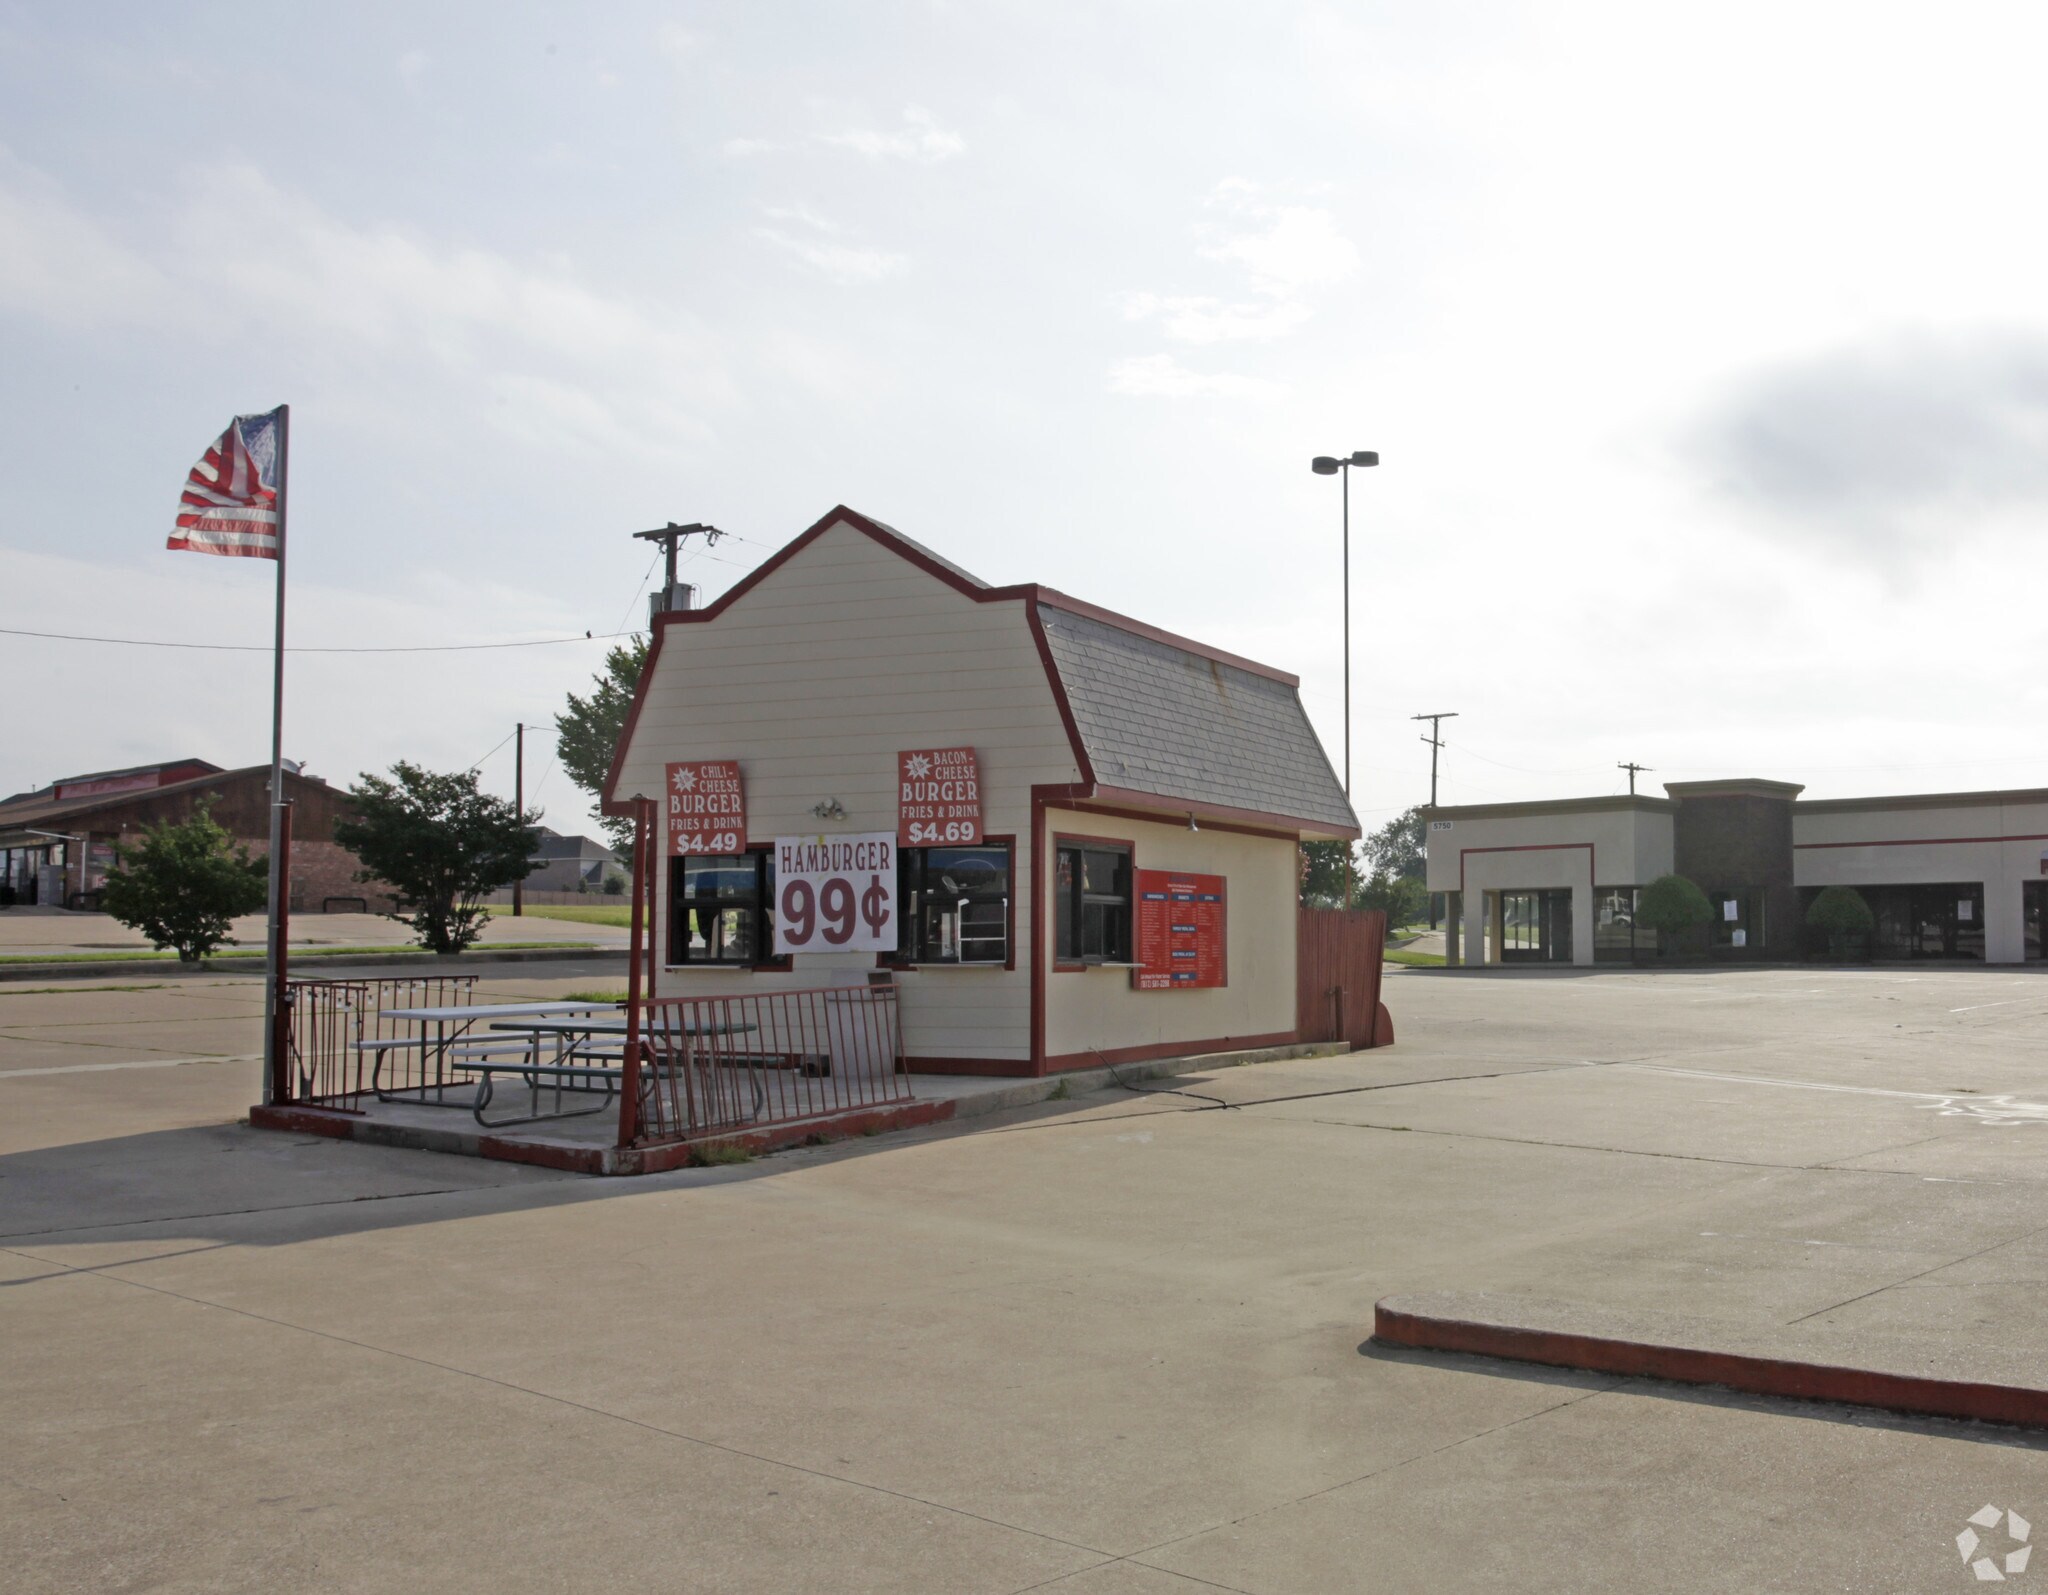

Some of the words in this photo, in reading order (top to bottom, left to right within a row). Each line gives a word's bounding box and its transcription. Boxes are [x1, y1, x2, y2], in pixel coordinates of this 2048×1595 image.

[935, 766, 976, 780] CHEESE
[699, 779, 740, 793] CHEESE
[902, 781, 977, 802] BURGER
[670, 794, 742, 814] BURGER
[902, 805, 934, 819] FRIES
[937, 806, 945, 818] &
[948, 804, 979, 818] DRINK
[670, 818, 700, 831] FRIES
[703, 818, 710, 830] &
[713, 816, 743, 829] DRINK
[908, 821, 975, 845] $4.69
[1433, 822, 1451, 830] 5750
[676, 832, 738, 855] $4.49
[781, 841, 890, 874] HAMBURGER
[781, 874, 891, 946] 99¢
